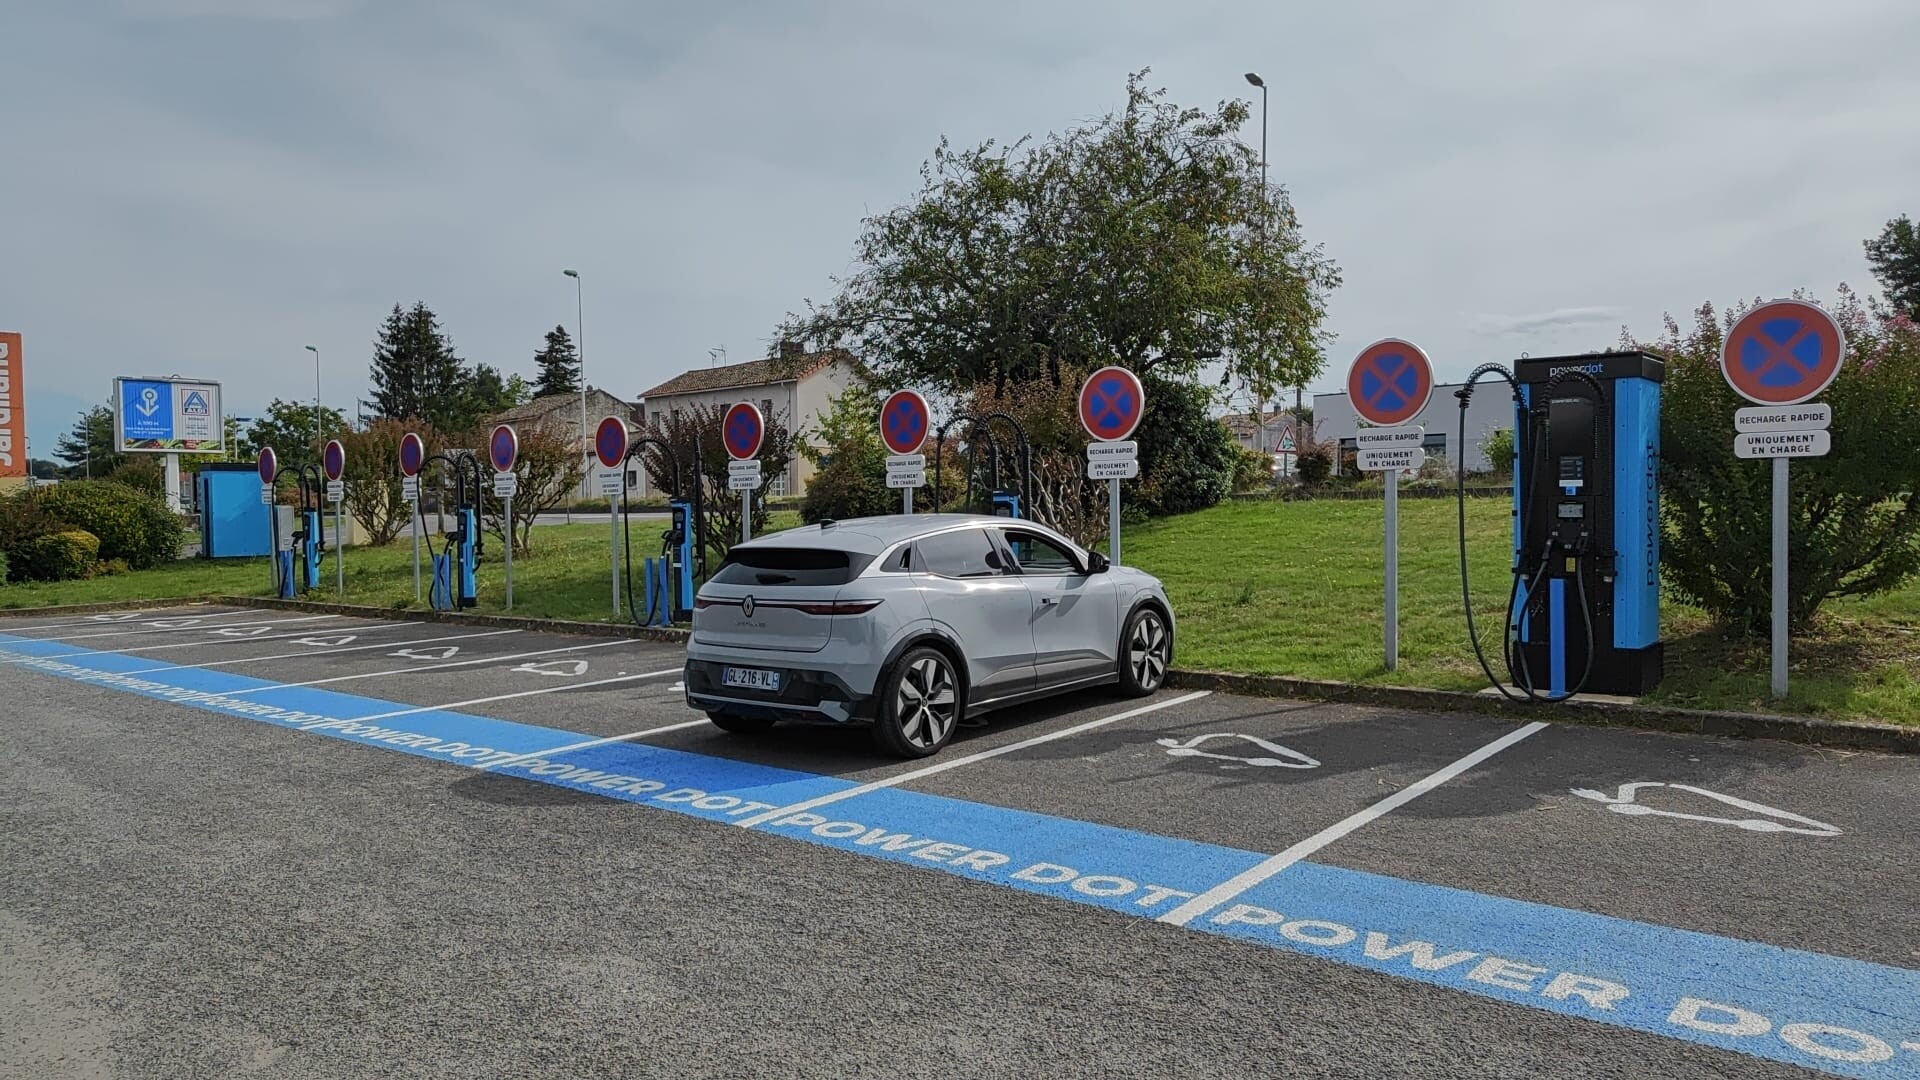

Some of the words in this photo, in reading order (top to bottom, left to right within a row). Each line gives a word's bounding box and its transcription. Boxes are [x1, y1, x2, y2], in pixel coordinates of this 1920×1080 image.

[1739, 414, 1787, 425] RECHARGE
[1790, 412, 1825, 422] RAPIDE
[1359, 434, 1393, 442] RECHARGE
[1395, 433, 1419, 441] RAPIDE
[1747, 434, 1815, 445] UNIQUEMENT
[1366, 451, 1413, 459] UNIQUEMENT
[1751, 446, 1765, 455] EN
[1770, 445, 1811, 454] CHARGE
[1094, 462, 1129, 470] UNIQUEMENT
[1368, 460, 1378, 468] EN
[1381, 459, 1410, 467] CHARGE
[1645, 439, 1655, 586] powerdot
[727, 667, 772, 686] GL-216-VL
[502, 759, 666, 795] POWER
[652, 787, 778, 817] DOT
[769, 811, 1011, 872] POWER
[1009, 861, 1198, 908] DOT
[1209, 903, 1630, 1012] POWER
[1666, 996, 1920, 1064] DO
